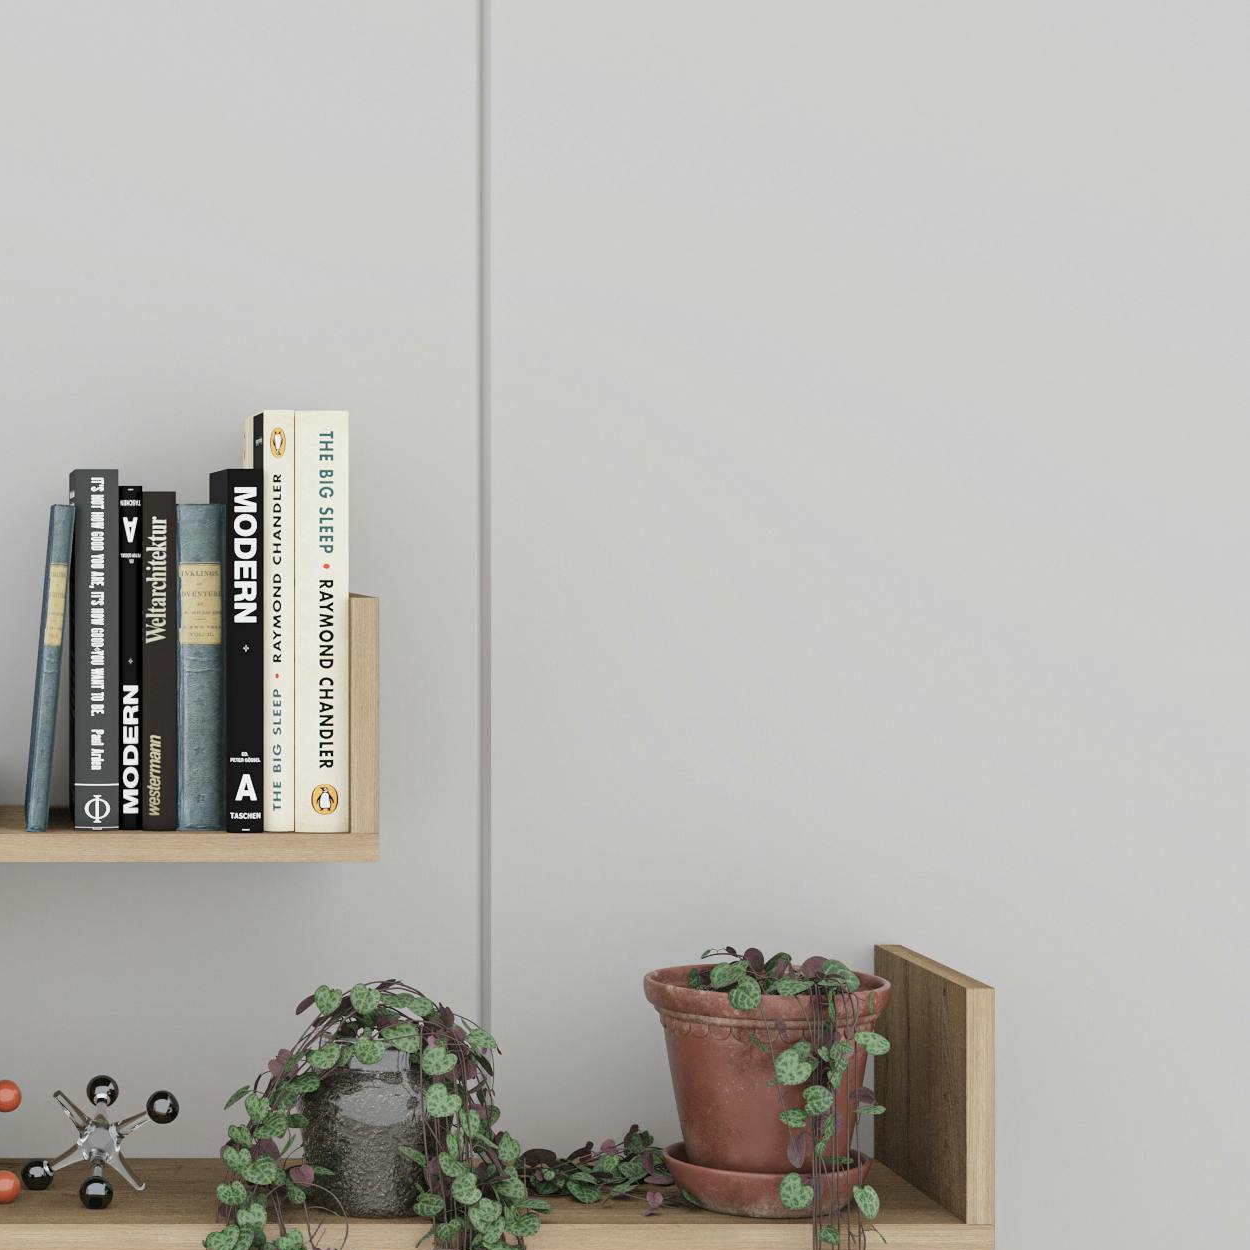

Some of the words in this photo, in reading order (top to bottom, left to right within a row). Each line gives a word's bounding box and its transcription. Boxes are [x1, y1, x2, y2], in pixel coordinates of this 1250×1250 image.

[318, 430, 334, 461] THE
[90, 476, 105, 493] IT'S
[318, 469, 334, 499] BIG
[90, 494, 105, 510] NOT
[119, 499, 142, 507] TASCHEN
[90, 511, 105, 530] HOW
[122, 516, 139, 543] A
[272, 474, 283, 566] CHANDLER
[318, 507, 334, 554] SLEEP
[90, 531, 105, 551] GOOD
[233, 486, 258, 624] MODERN
[90, 553, 105, 570] YOU
[88, 570, 105, 589] ARE,
[145, 515, 168, 645] Weltarchitektur
[90, 591, 105, 606] IT'S
[90, 607, 105, 626] HOW
[272, 573, 283, 663] RAYMOND
[318, 579, 335, 670] RAYMOND
[90, 667, 105, 690] WANT
[90, 691, 105, 702] TO
[272, 688, 283, 736] SLEEP
[318, 676, 334, 769] CHANDLER
[90, 728, 105, 746] Paul
[122, 684, 140, 815] MODERN
[90, 747, 105, 771] Arden
[272, 743, 283, 773] BIG
[146, 734, 163, 817] westermann
[234, 773, 258, 802] A
[272, 781, 283, 812] THE
[229, 811, 262, 820] TASCHEN
